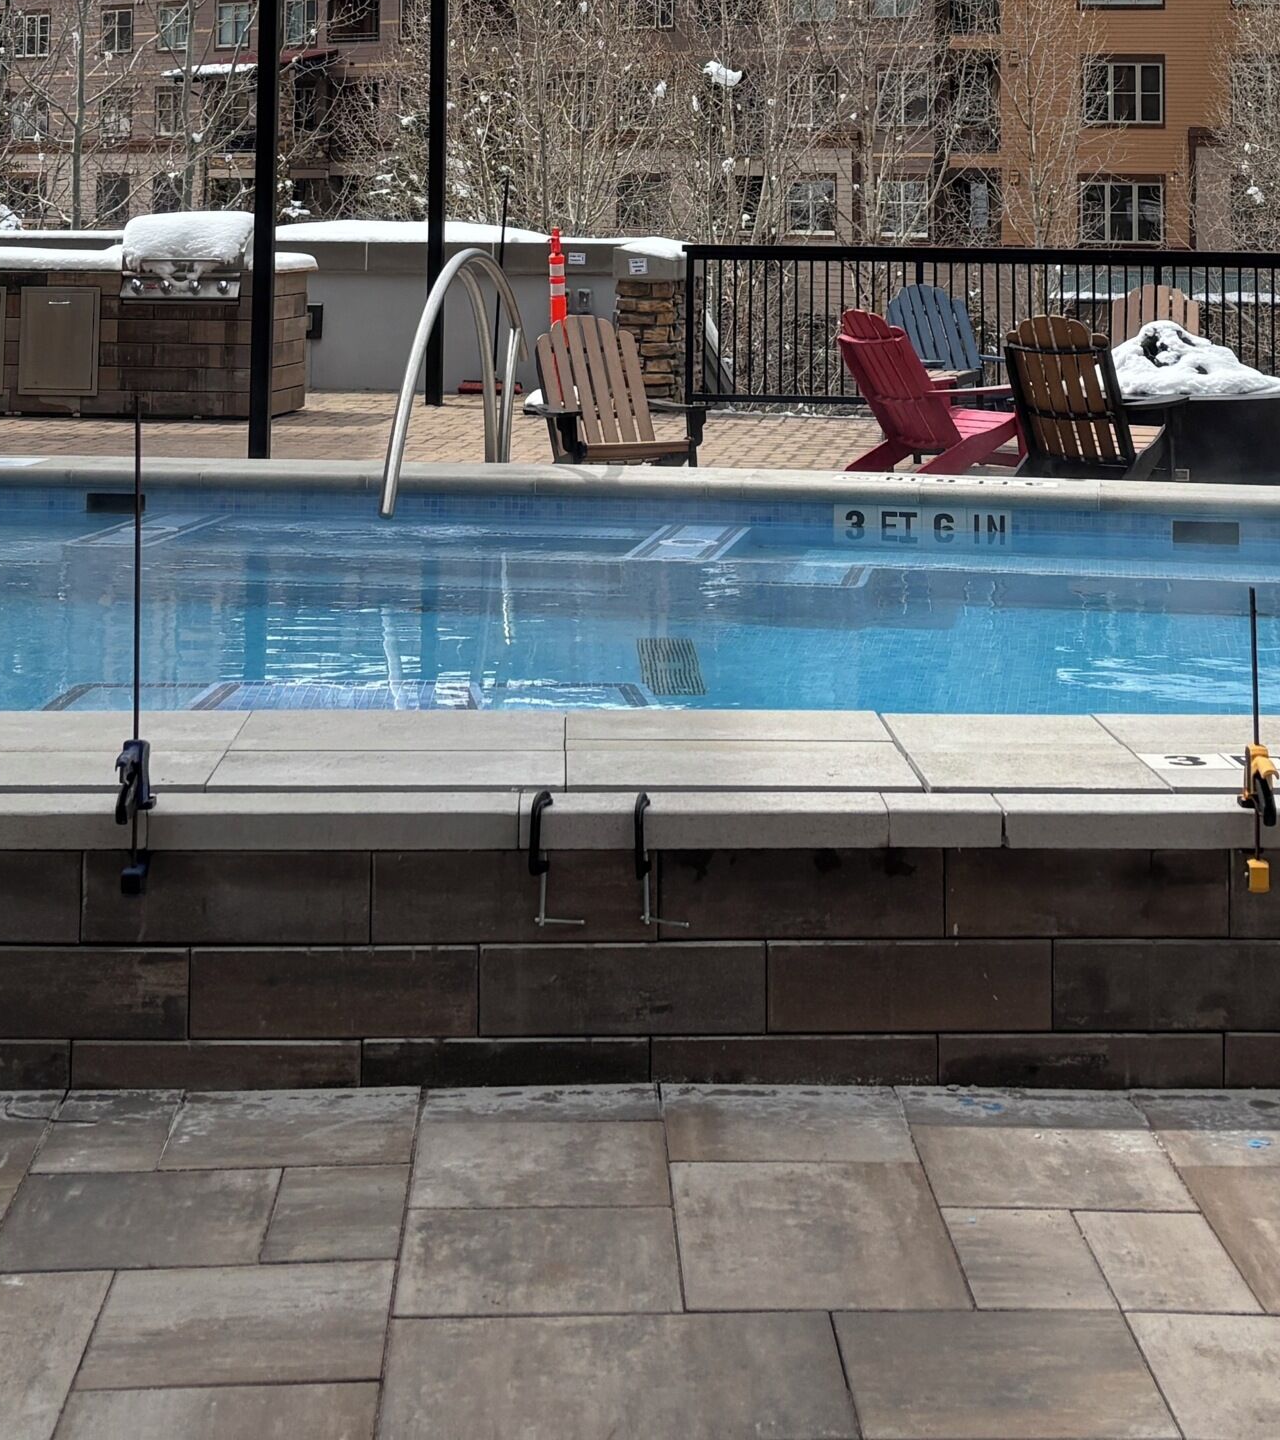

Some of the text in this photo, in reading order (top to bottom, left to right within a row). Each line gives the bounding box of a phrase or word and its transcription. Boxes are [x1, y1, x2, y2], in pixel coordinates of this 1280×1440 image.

[845, 510, 865, 530] 3
[974, 514, 1006, 535] IN
[1164, 755, 1207, 767] 3
